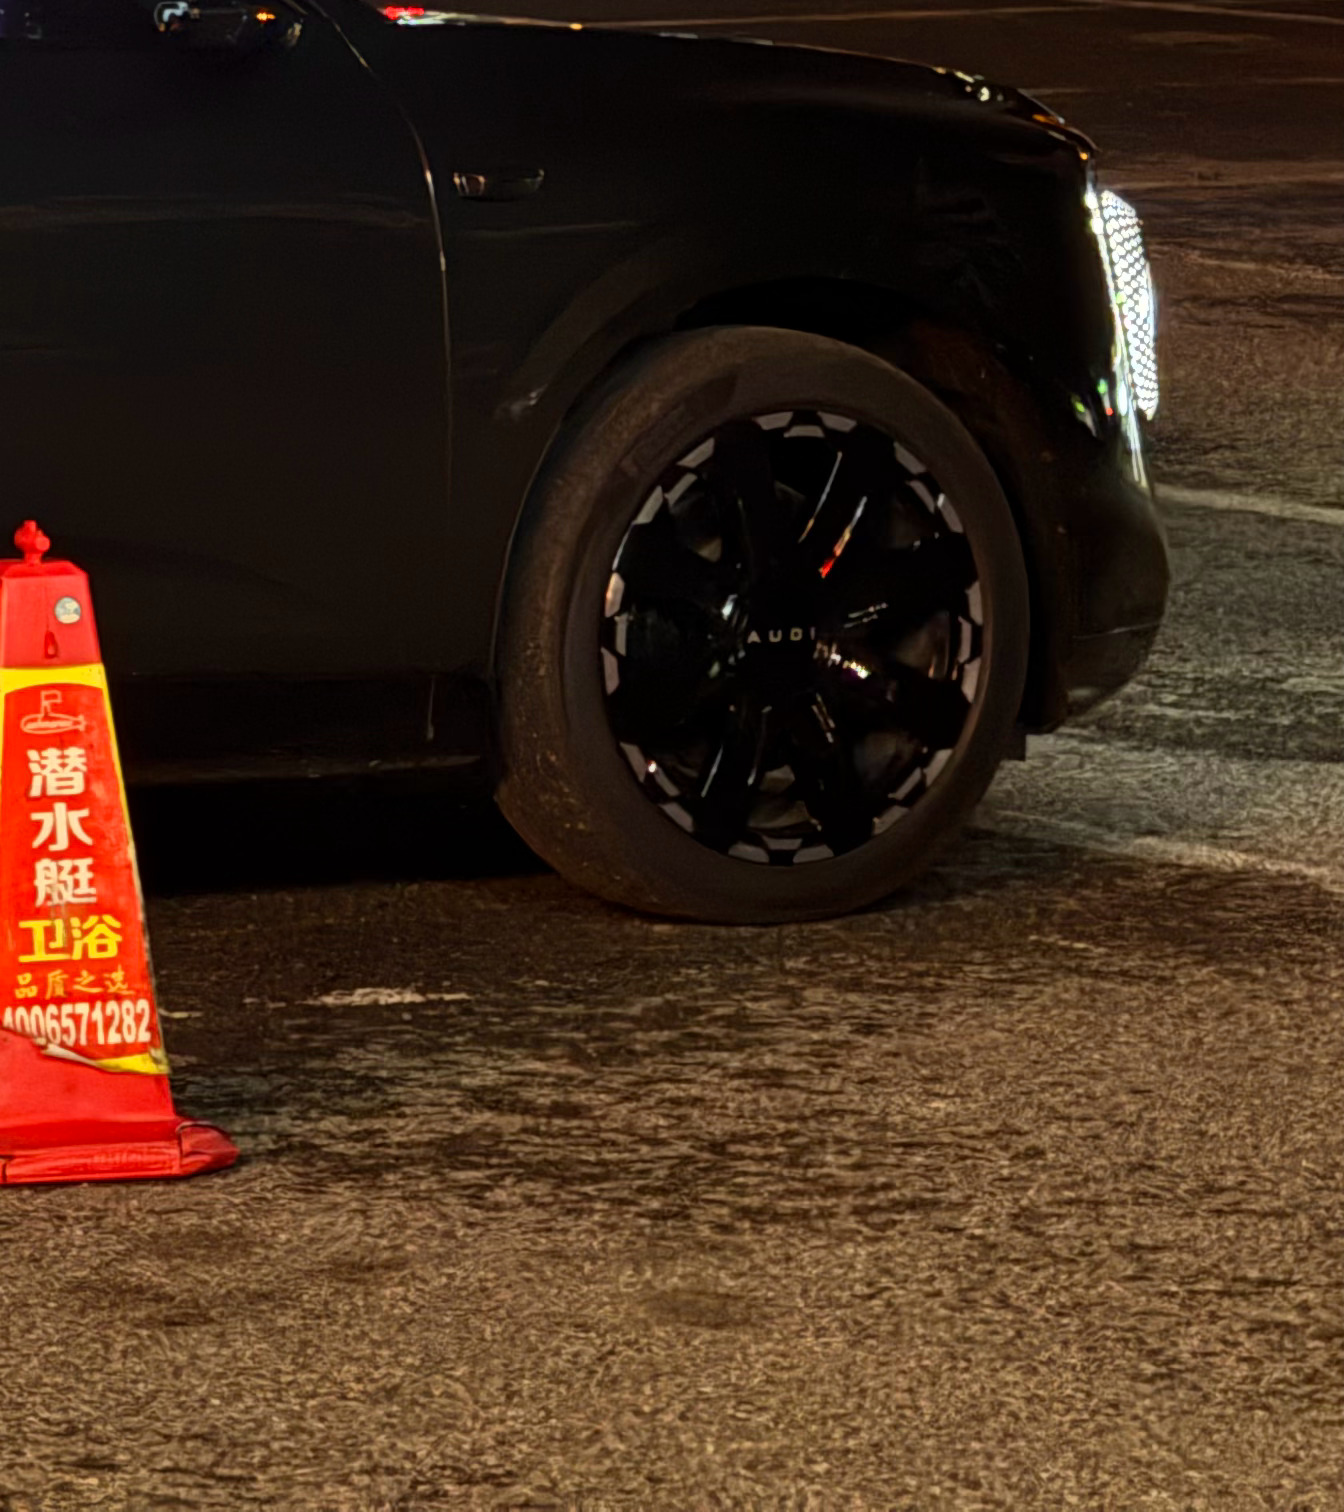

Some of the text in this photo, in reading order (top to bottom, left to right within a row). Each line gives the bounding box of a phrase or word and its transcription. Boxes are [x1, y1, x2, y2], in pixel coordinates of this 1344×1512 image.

[746, 626, 816, 644] AUDI
[26, 746, 98, 908] 潜水艇
[17, 914, 123, 963] 卫浴
[14, 964, 136, 1000] 品质之选
